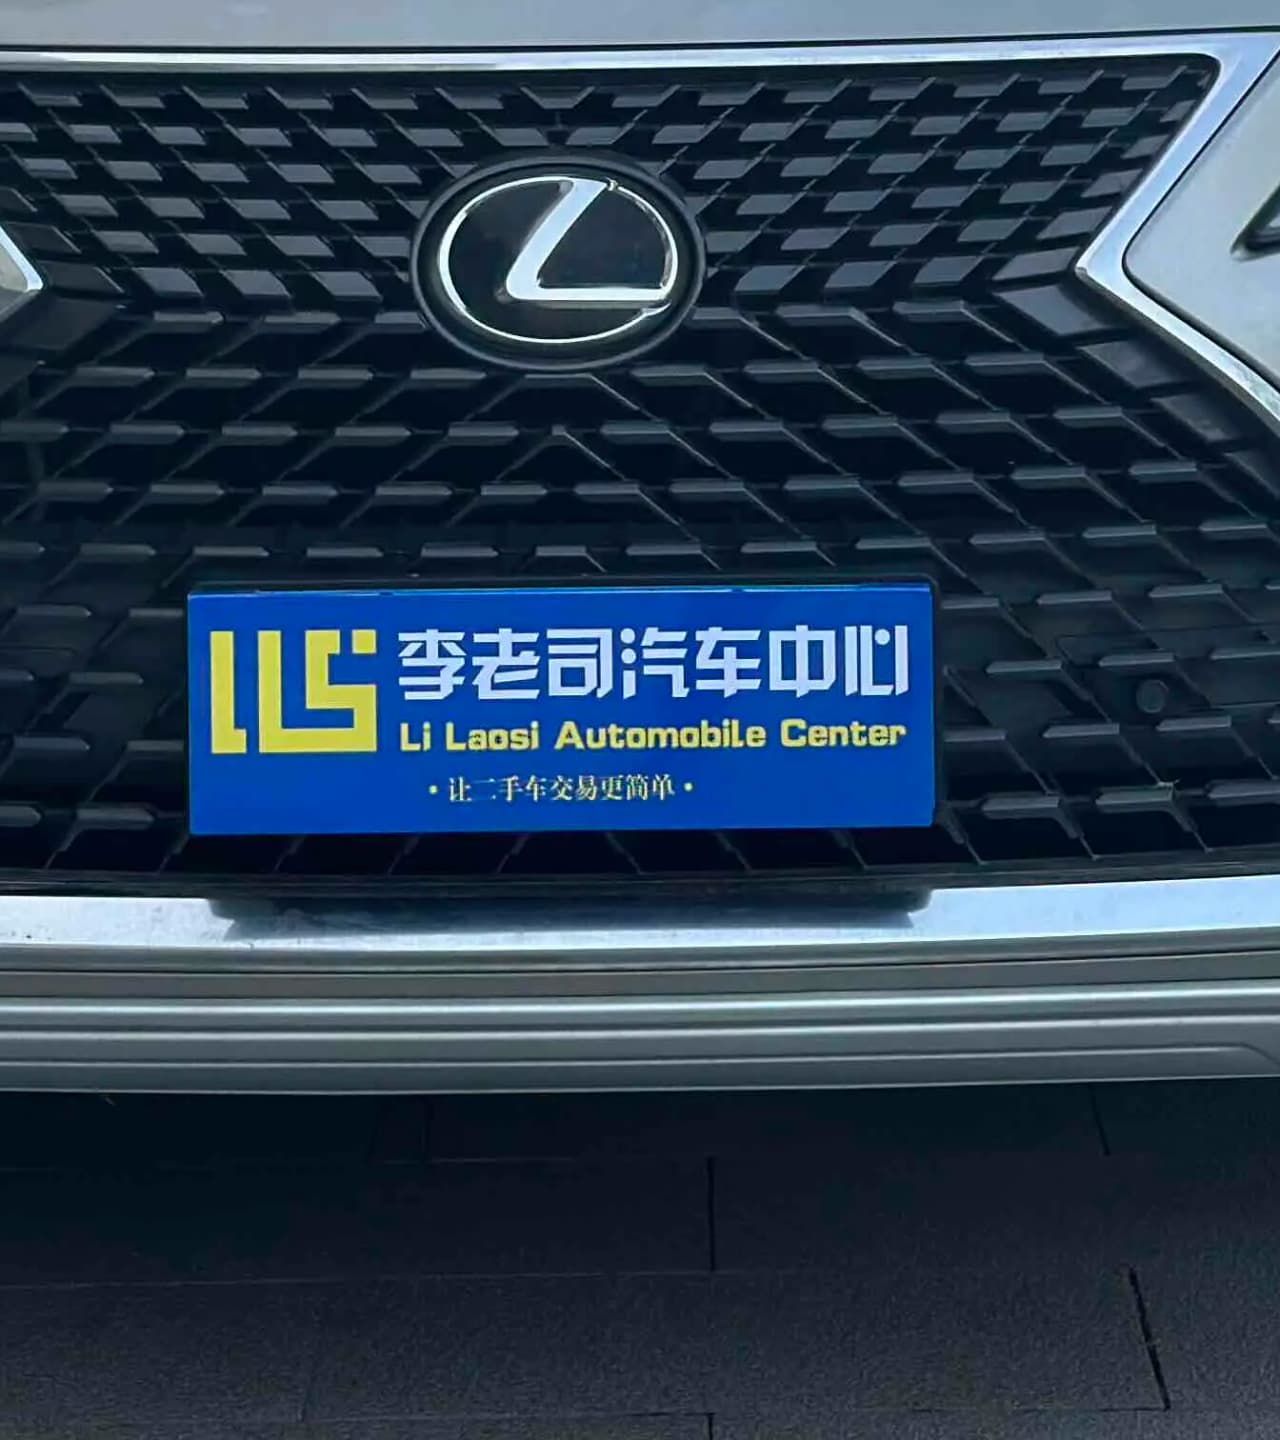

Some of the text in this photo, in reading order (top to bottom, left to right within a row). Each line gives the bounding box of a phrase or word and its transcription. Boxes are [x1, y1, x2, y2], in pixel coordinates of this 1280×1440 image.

[398, 624, 909, 700] 李老司汽车中心
[400, 718, 907, 751] Li Laosi Automobile Center
